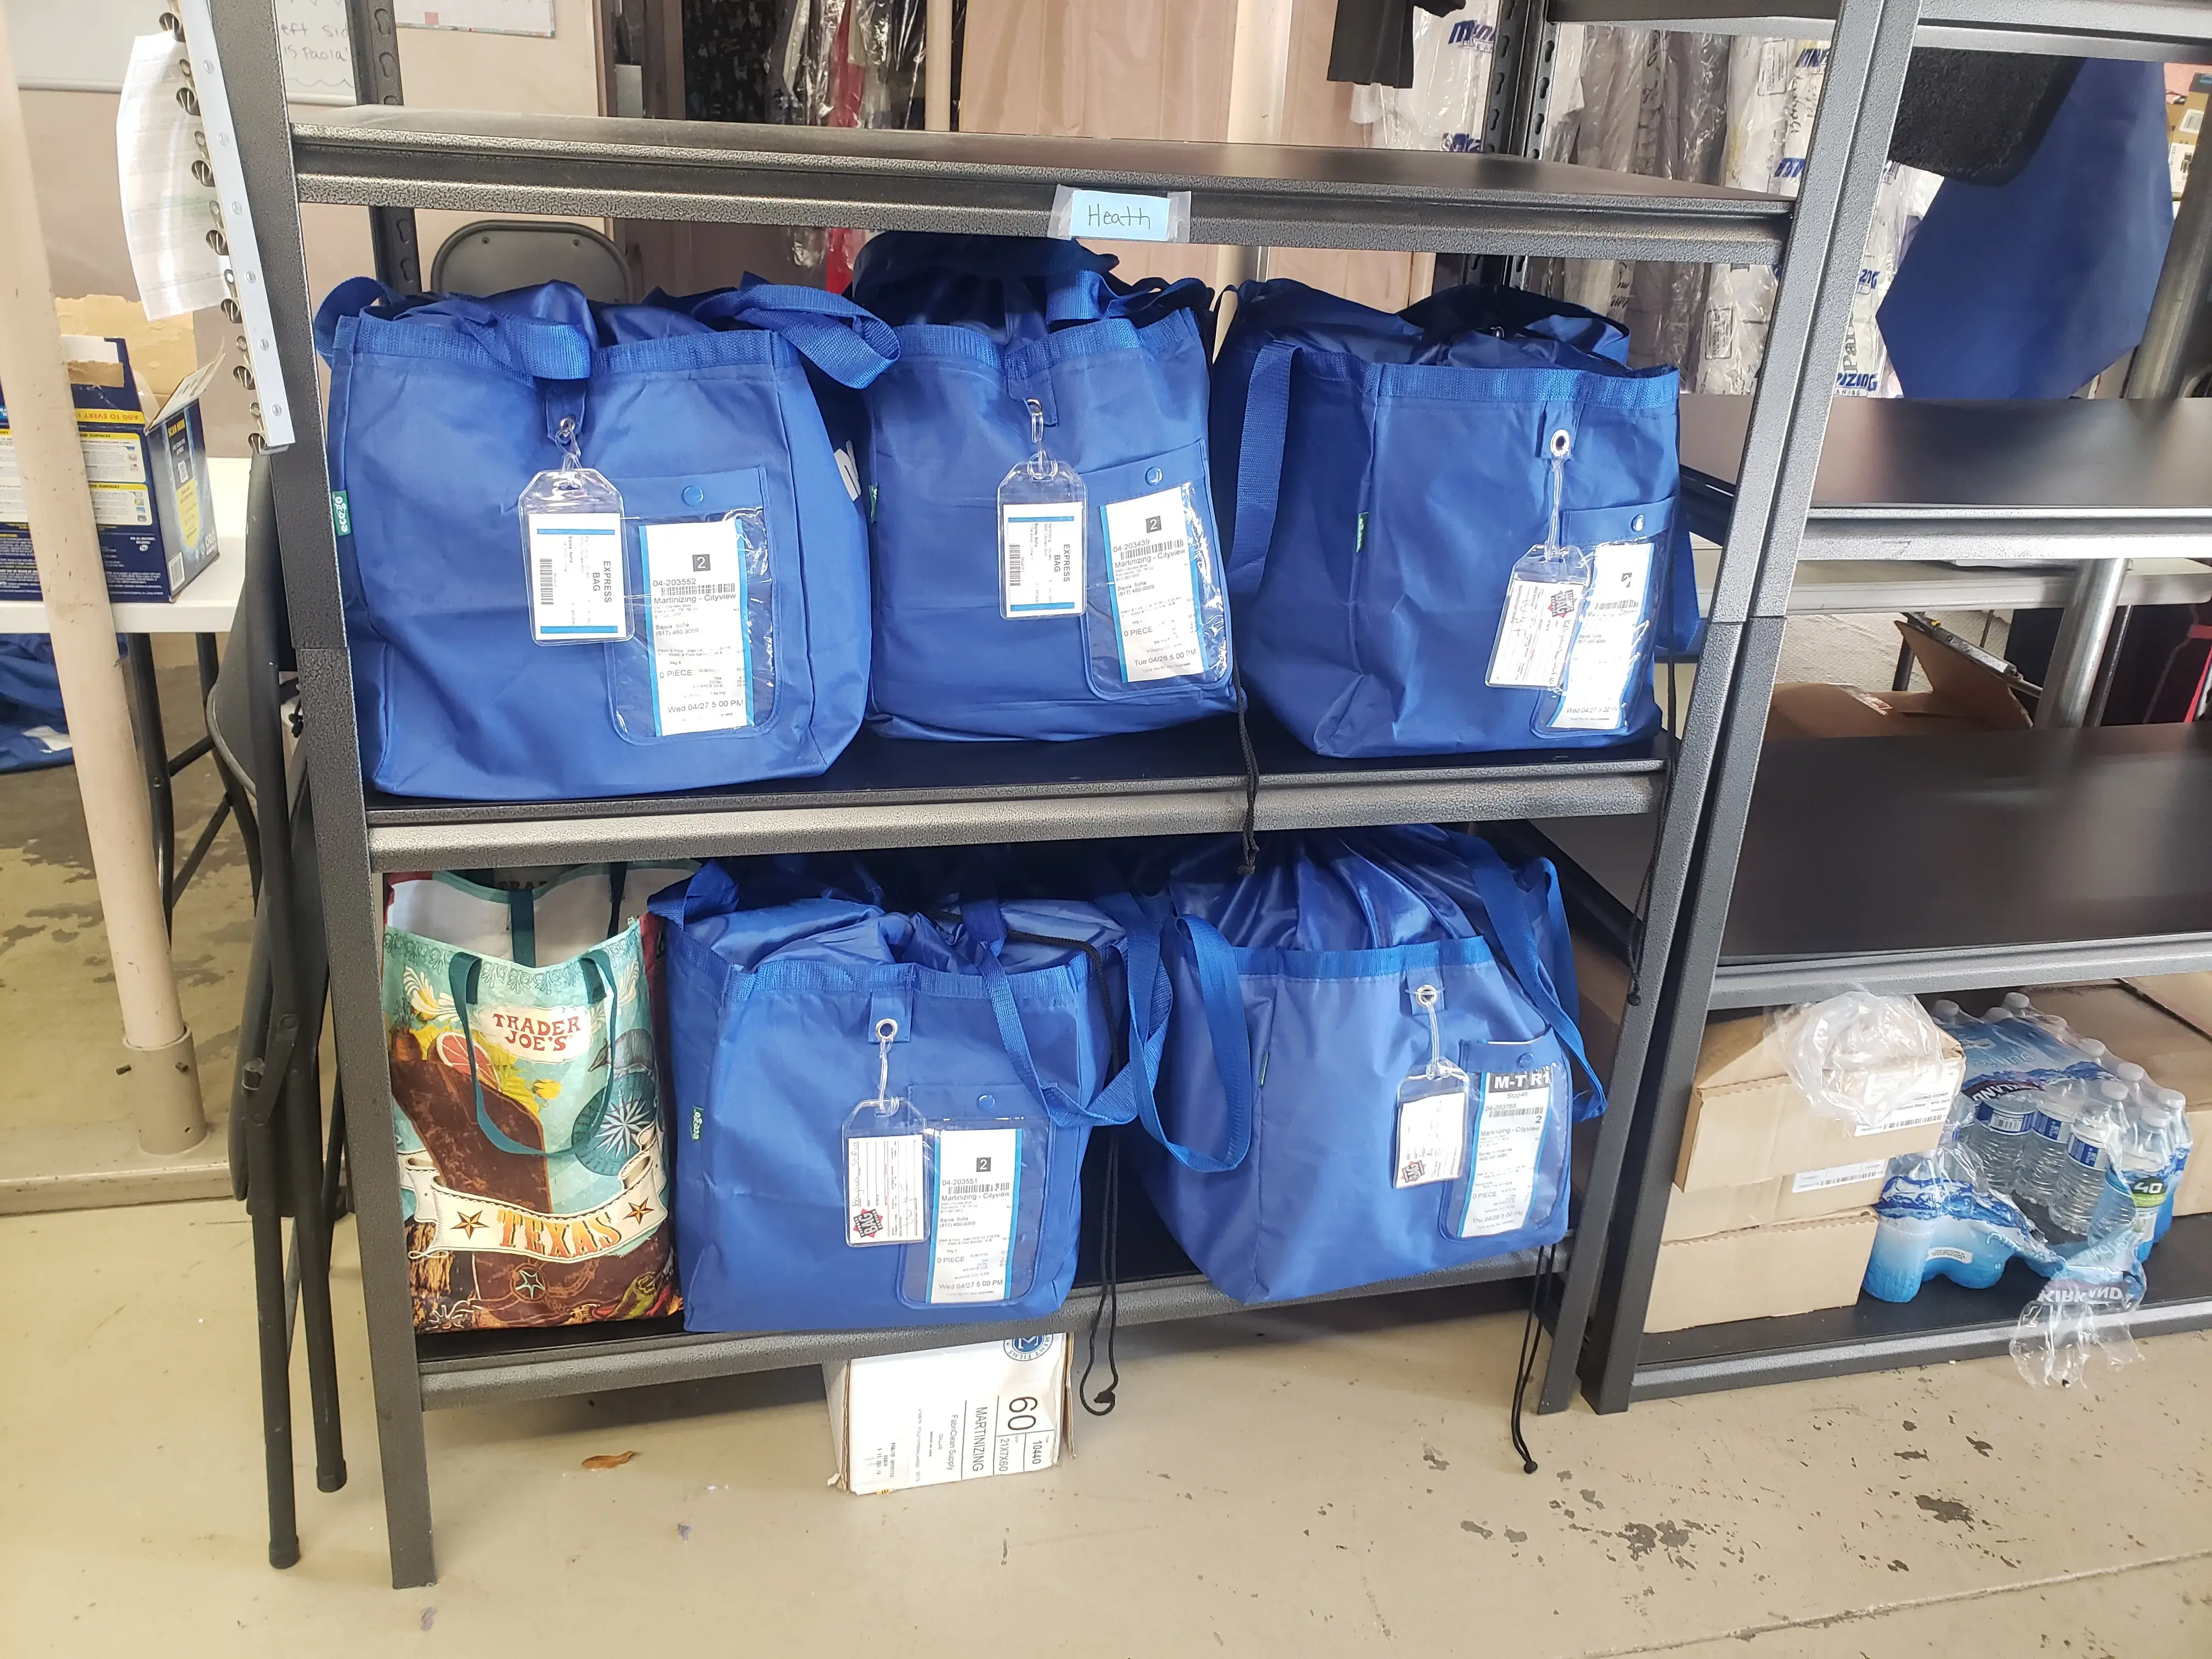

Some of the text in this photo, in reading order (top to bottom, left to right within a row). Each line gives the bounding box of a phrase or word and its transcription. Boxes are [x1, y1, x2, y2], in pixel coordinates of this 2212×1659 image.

[281, 22, 349, 37] eft Sid
[302, 47, 347, 61] Paola'
[1149, 518, 1158, 531] 2
[1113, 539, 1150, 552] 04-203439
[697, 556, 707, 569] 2
[1115, 556, 1151, 568] Martinizing
[1158, 549, 1186, 560] Cityview
[592, 572, 601, 591] BAG
[603, 561, 612, 603] EXPRESS
[653, 578, 696, 586] 04-203552
[654, 596, 697, 604] Martinizing
[704, 593, 736, 601] Cityview
[1130, 627, 1153, 636] PIECE
[1186, 648, 1197, 657] PM
[688, 702, 709, 710] 04/27
[492, 1013, 582, 1036] TRADER
[505, 1030, 567, 1051] JOE'S
[1535, 1115, 1542, 1124] 2
[980, 1159, 988, 1170] 2
[942, 1178, 977, 1186] 04-203551
[2134, 1182, 2163, 1193] 40
[860, 1212, 876, 1234] BAG
[498, 1209, 622, 1259] TEXAS
[1007, 1396, 1038, 1430] 60
[973, 1407, 988, 1472] MARTINIZING
[947, 1449, 956, 1470] Supply
[998, 1438, 1009, 1471] 21X7X60
[1032, 1441, 1043, 1464] 10440
